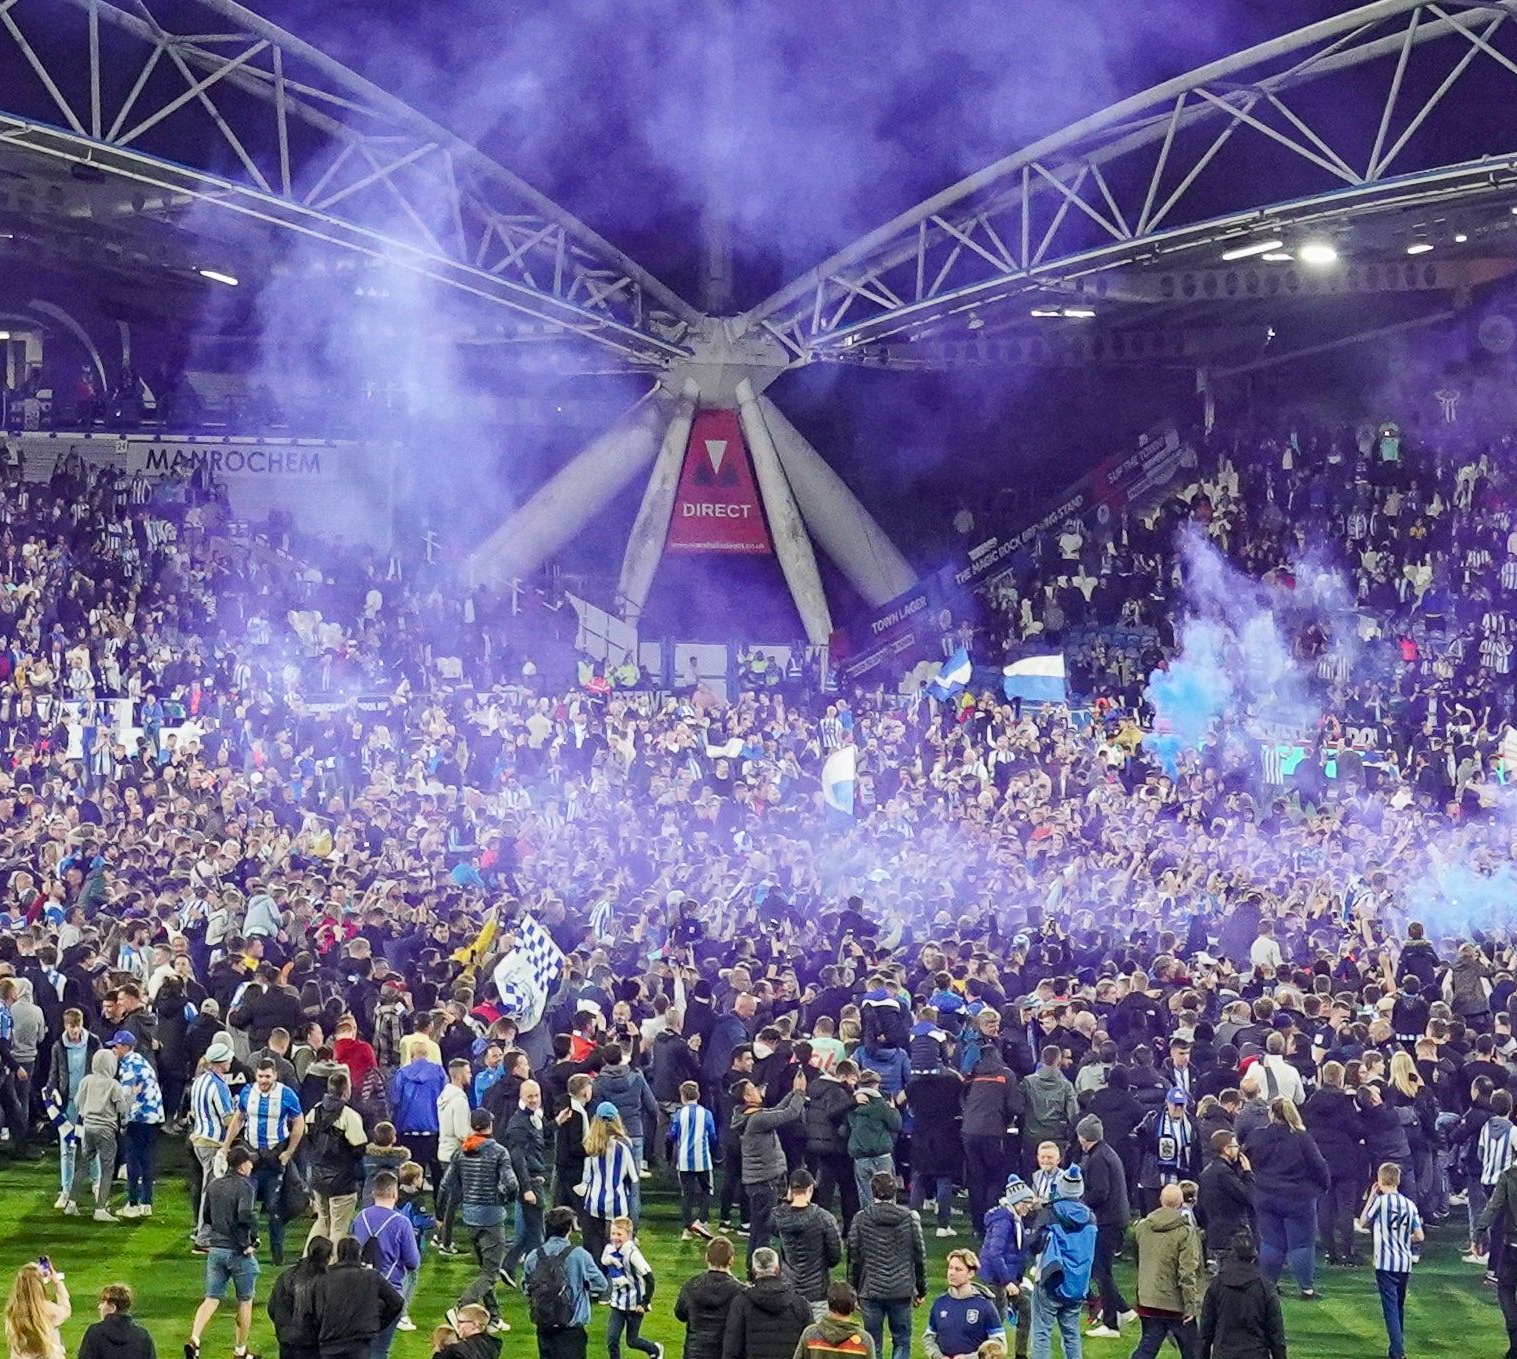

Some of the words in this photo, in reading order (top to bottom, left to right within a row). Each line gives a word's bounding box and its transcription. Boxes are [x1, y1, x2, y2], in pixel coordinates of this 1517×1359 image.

[145, 447, 322, 475] MANROCHEM
[682, 503, 752, 518] DIRECT
[955, 567, 973, 585] THE
[971, 549, 1000, 576] MAGIC
[871, 611, 899, 635] TOWN
[898, 595, 928, 621] LAGER
